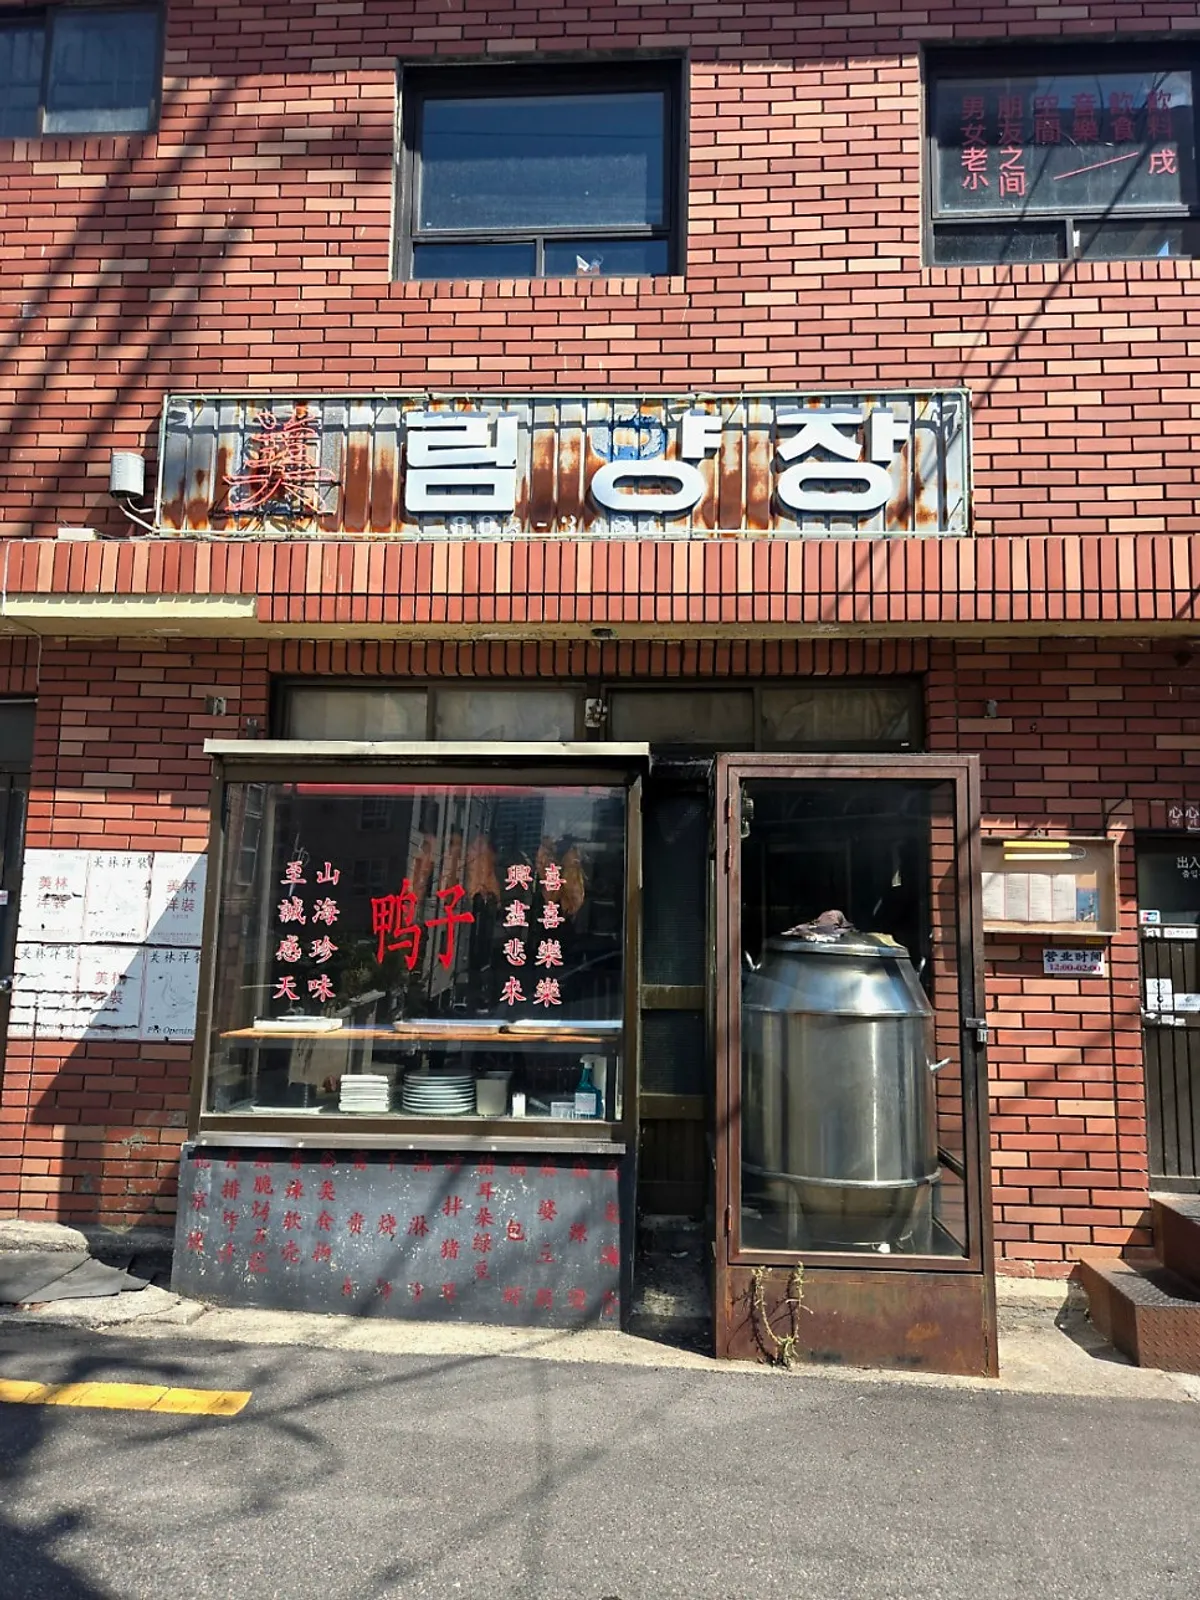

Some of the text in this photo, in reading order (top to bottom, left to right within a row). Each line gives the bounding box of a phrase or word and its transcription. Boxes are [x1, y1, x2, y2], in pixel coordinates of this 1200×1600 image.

[961, 96, 989, 191] 男女老小
[998, 94, 1026, 197] 朋友之间
[273, 860, 307, 1000] 至誠感天
[308, 861, 341, 1003] 山海珍味
[371, 877, 475, 972] 鸭子
[533, 862, 567, 1008] 喜喜樂樂
[1044, 951, 1102, 963] 营业时间
